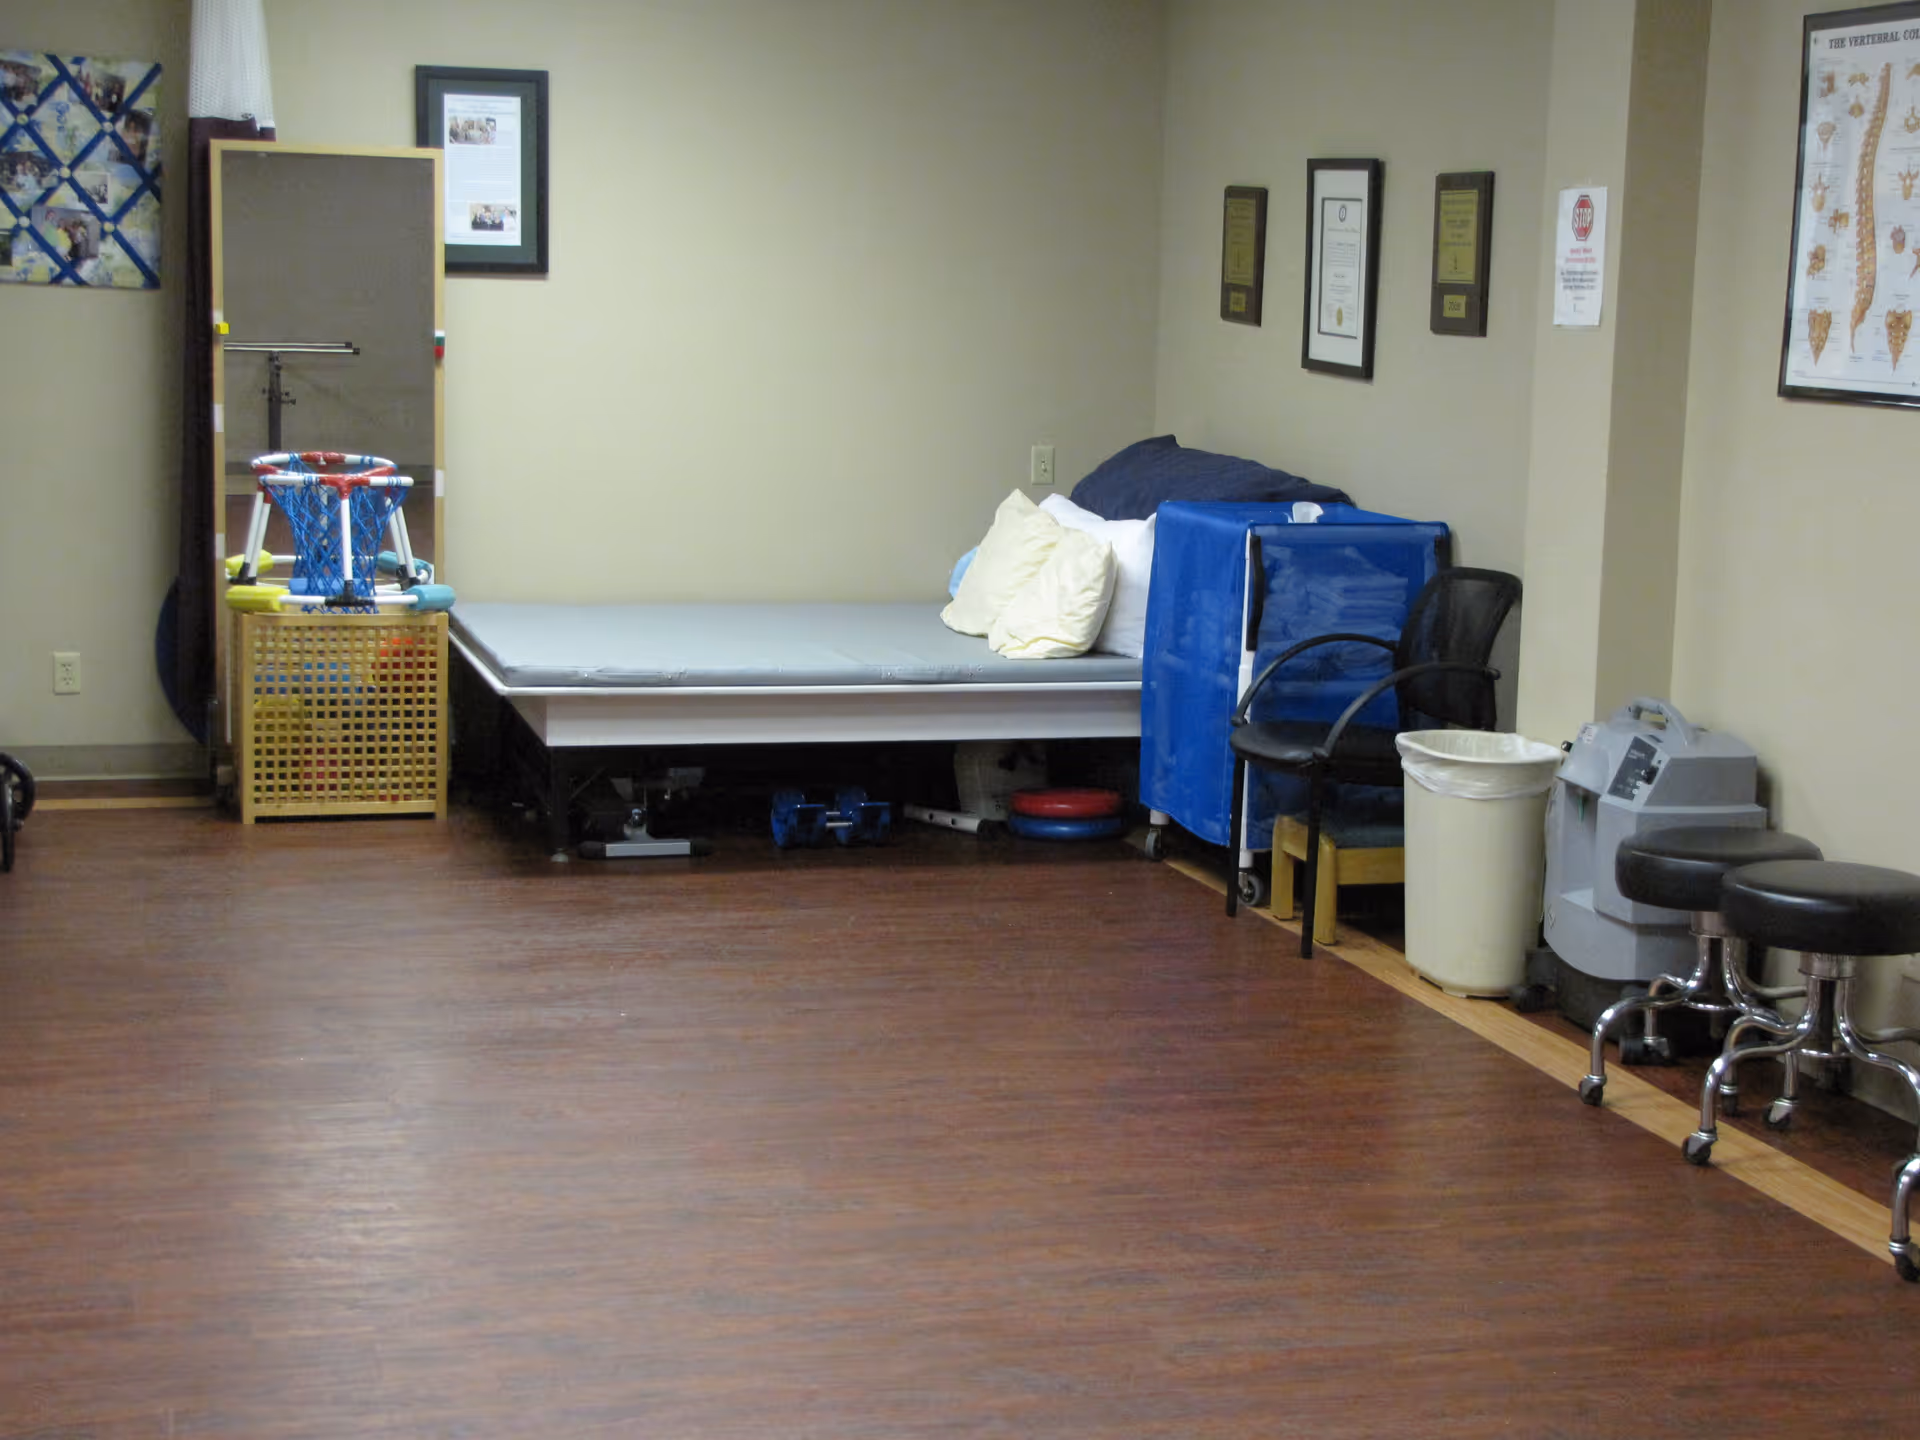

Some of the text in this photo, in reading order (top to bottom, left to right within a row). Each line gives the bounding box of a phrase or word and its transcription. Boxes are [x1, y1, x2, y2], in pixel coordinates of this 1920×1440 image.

[1828, 38, 1846, 49] THE
[1848, 31, 1900, 47] VERTEBRAL
[1574, 207, 1592, 228] STOP
